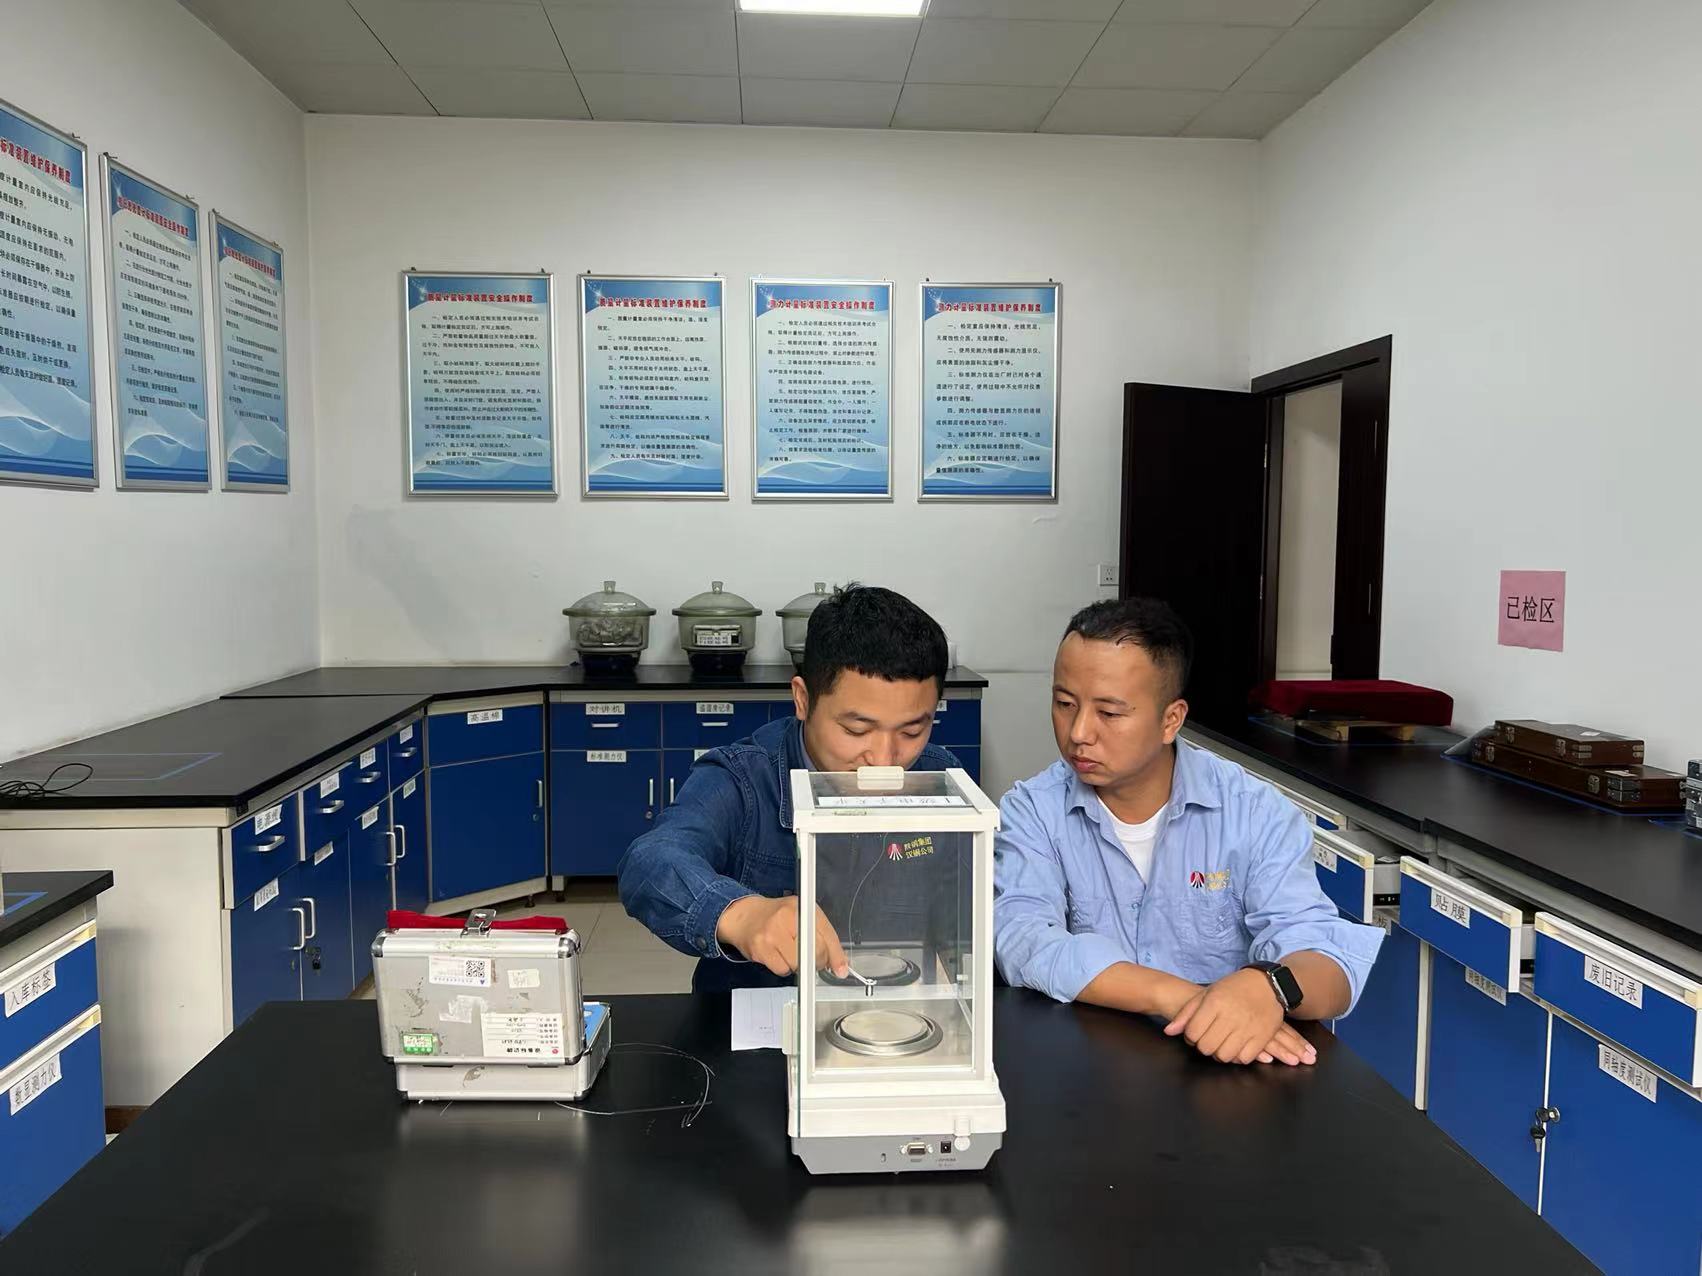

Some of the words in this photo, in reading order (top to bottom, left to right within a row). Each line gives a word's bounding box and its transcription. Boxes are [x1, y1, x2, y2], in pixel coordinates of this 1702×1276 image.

[1507, 595, 1555, 623] 已检区
[1435, 893, 1466, 923] 贴膜
[9, 970, 51, 1011] 入库标签
